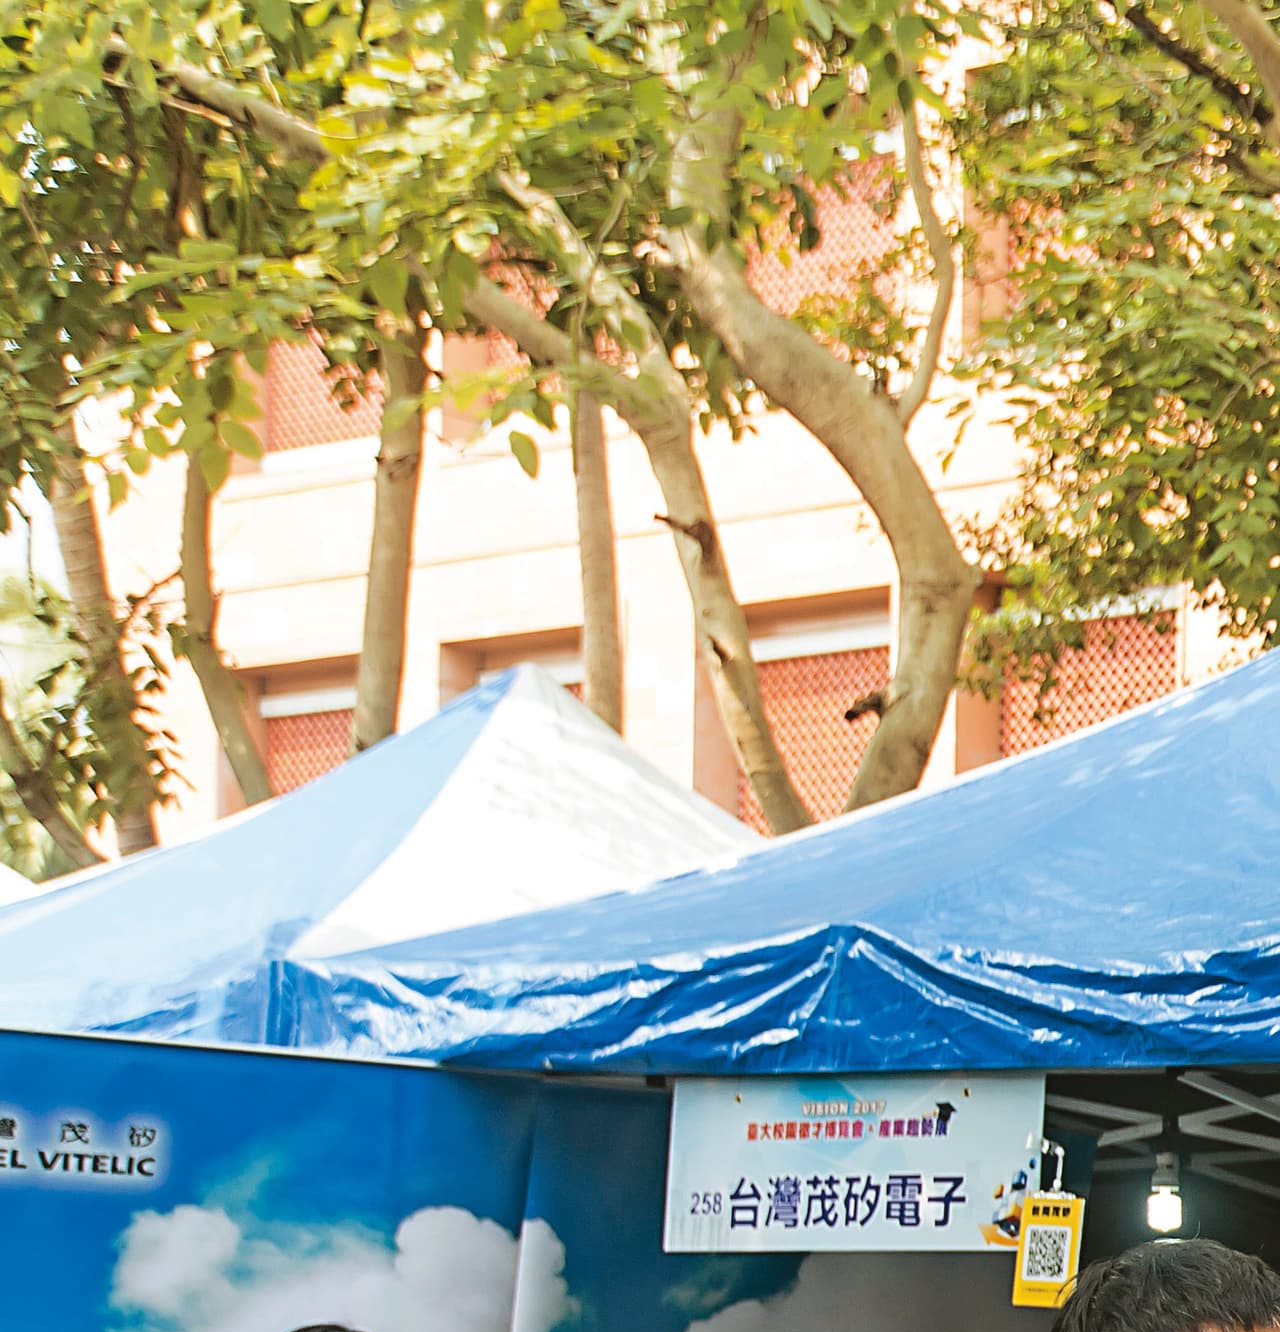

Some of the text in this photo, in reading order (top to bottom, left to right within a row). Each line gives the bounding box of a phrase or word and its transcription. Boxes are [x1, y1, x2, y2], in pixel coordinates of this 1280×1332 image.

[802, 1100, 849, 1116] VISION
[37, 1149, 157, 1177] VITELIC
[690, 1174, 967, 1229] 258 台灣茂矽電子
